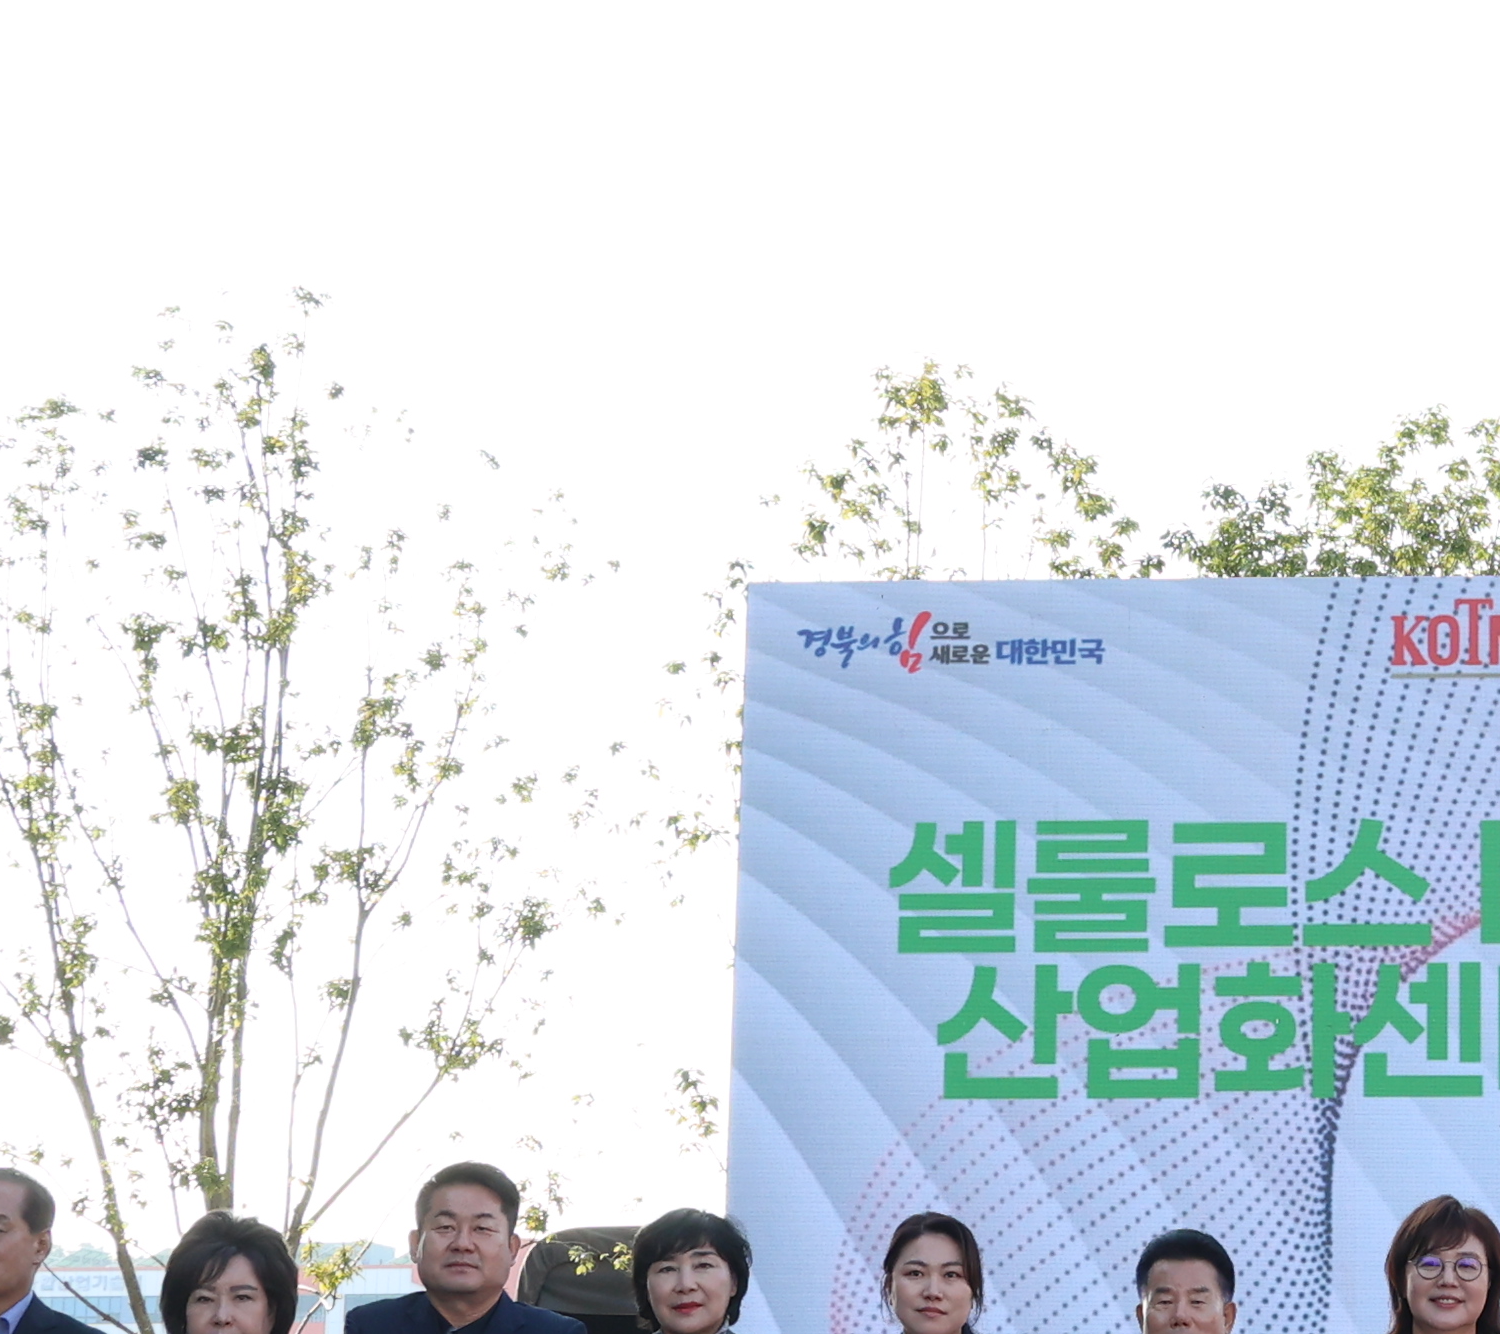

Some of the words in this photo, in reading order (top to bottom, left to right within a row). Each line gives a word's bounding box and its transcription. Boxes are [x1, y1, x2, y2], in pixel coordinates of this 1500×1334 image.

[797, 624, 881, 670] 경북의
[929, 643, 991, 665] 새로운
[994, 638, 1106, 666] 대한민국
[888, 817, 1431, 954] 셀룰로스
